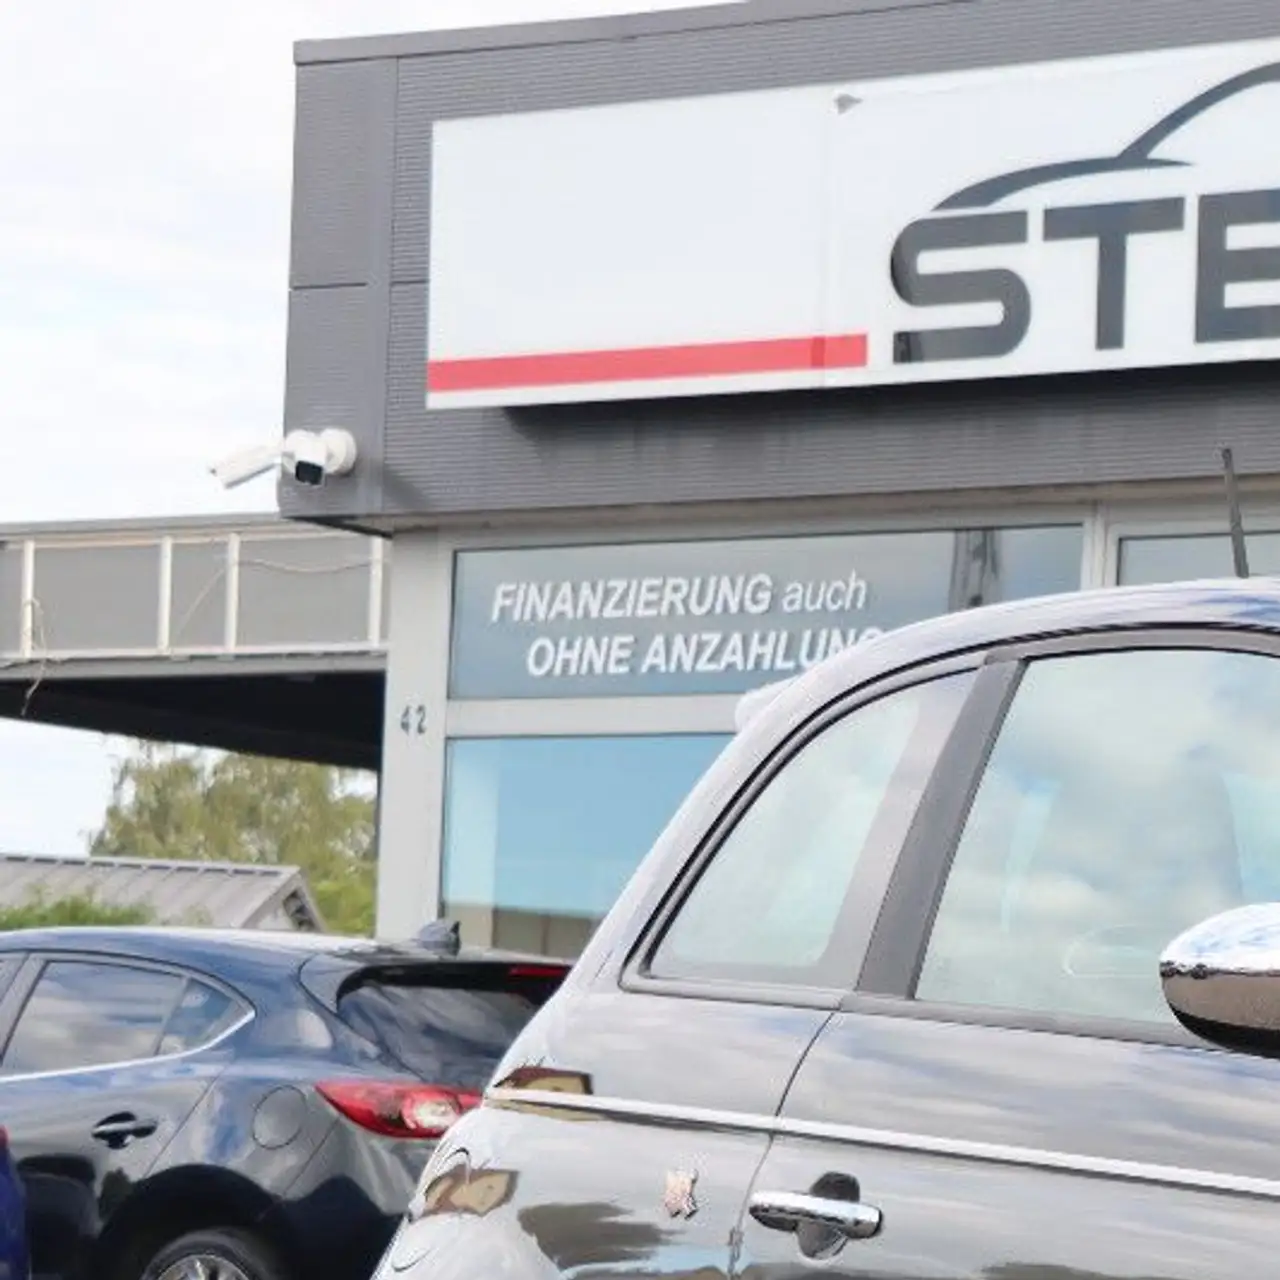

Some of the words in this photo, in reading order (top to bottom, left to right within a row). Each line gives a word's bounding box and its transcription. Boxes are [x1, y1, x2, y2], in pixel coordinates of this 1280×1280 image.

[491, 573, 773, 623] FINANZIERUNG
[782, 568, 868, 613] auch
[526, 635, 634, 677] OHNE
[641, 626, 884, 675] ANZAHLUN
[400, 704, 427, 736] 42
